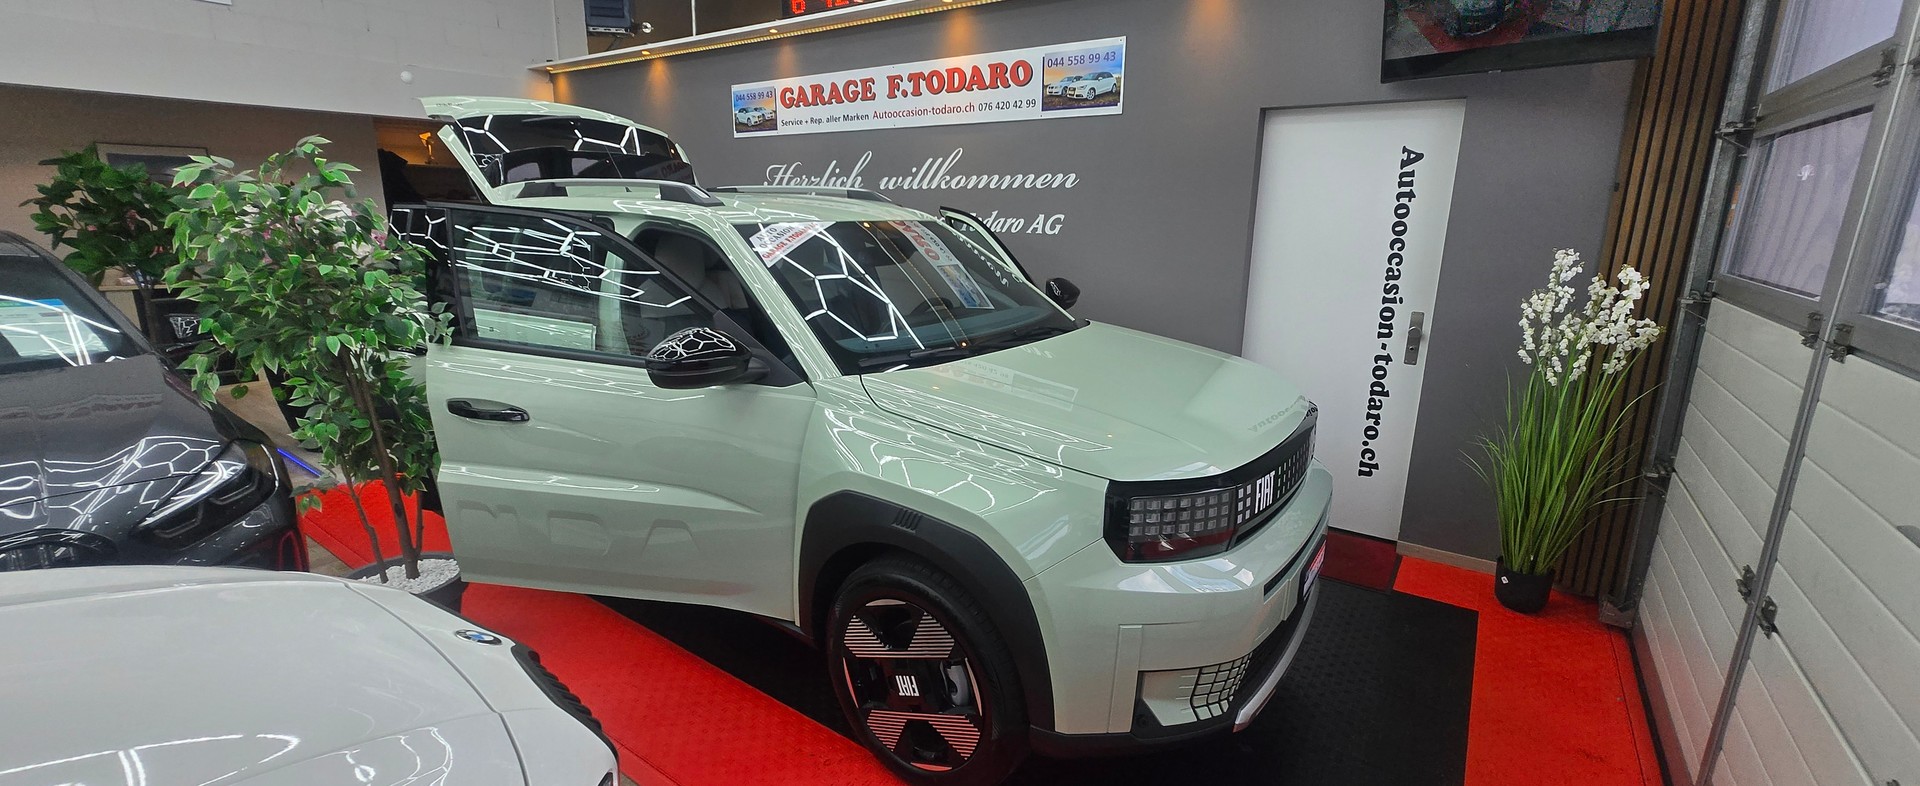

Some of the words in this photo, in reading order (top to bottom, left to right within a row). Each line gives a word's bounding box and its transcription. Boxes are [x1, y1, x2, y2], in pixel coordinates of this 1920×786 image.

[1047, 57, 1065, 68] 044
[1067, 55, 1086, 66] 558
[1088, 53, 1101, 64] 99
[1103, 51, 1116, 62] 43
[779, 77, 877, 109] GARAGE
[887, 59, 1034, 99] F.TODARO
[735, 93, 746, 102] 044
[746, 92, 757, 101] 558
[758, 91, 765, 100] 99
[765, 90, 774, 99] 43
[781, 118, 804, 127] Service
[810, 117, 825, 126] Rep.
[826, 115, 841, 124] aller
[843, 113, 869, 122] Marken
[872, 102, 975, 120] Autooccasion-todaro.ch
[978, 101, 993, 112] 076
[994, 100, 1011, 111] 420
[1012, 99, 1024, 110] 42
[1025, 98, 1037, 109] 99
[763, 150, 873, 188] Herzlich
[879, 148, 1079, 190] willkommen
[1026, 213, 1066, 235] AG
[1358, 145, 1425, 478] Autooccasion-todaro.ch
[1254, 470, 1276, 515] FIAT
[895, 675, 920, 697] FIAT
